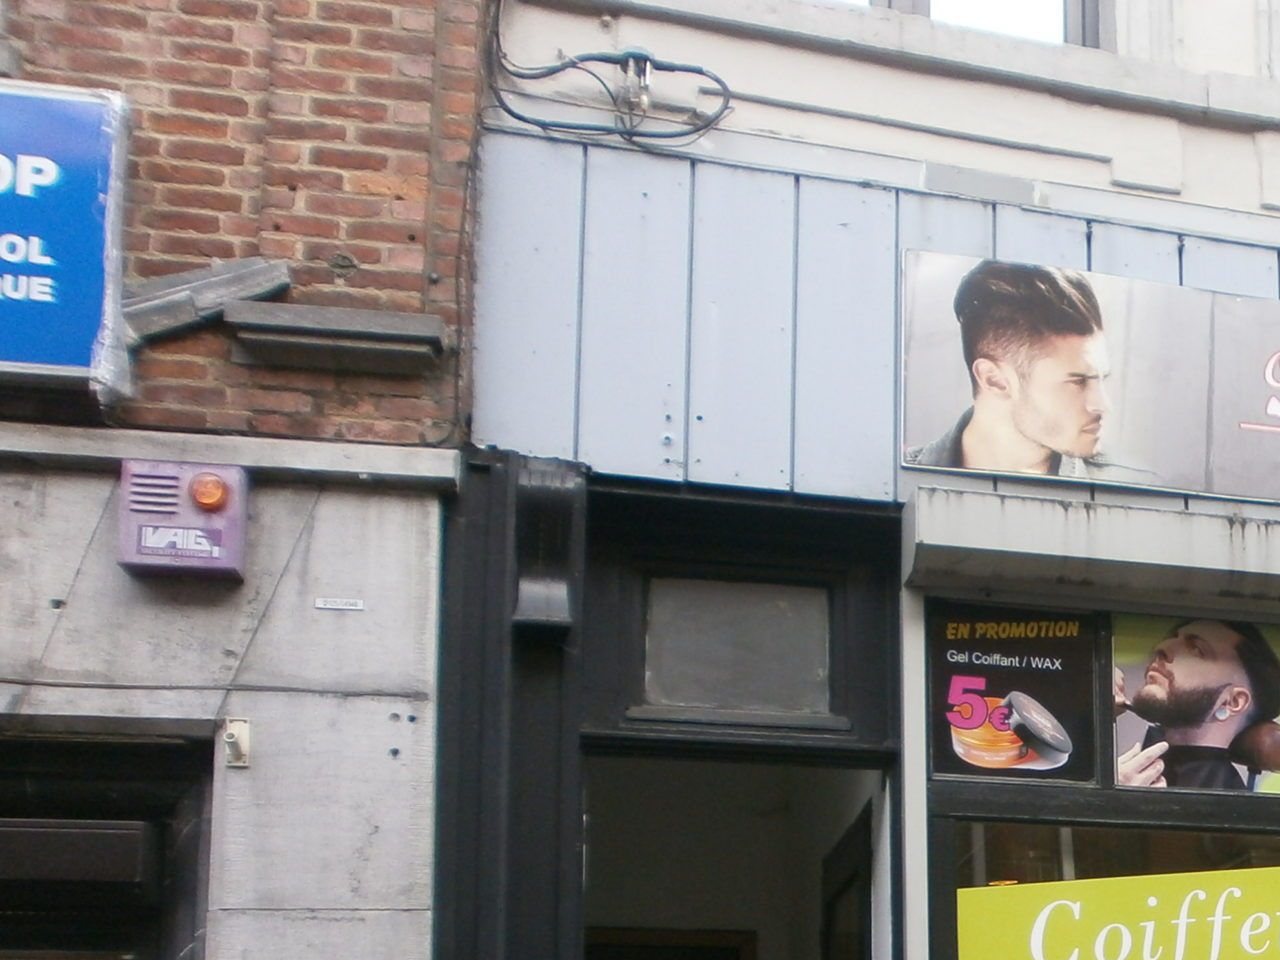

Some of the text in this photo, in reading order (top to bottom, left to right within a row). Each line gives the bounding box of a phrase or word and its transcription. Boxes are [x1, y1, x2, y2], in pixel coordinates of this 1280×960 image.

[0, 274, 54, 301] UE
[946, 620, 1080, 640] EN PROMOTION
[947, 650, 968, 663] Gel
[972, 652, 1020, 667] Coiffant
[1030, 657, 1063, 670] WAX
[946, 675, 1011, 732] 5€
